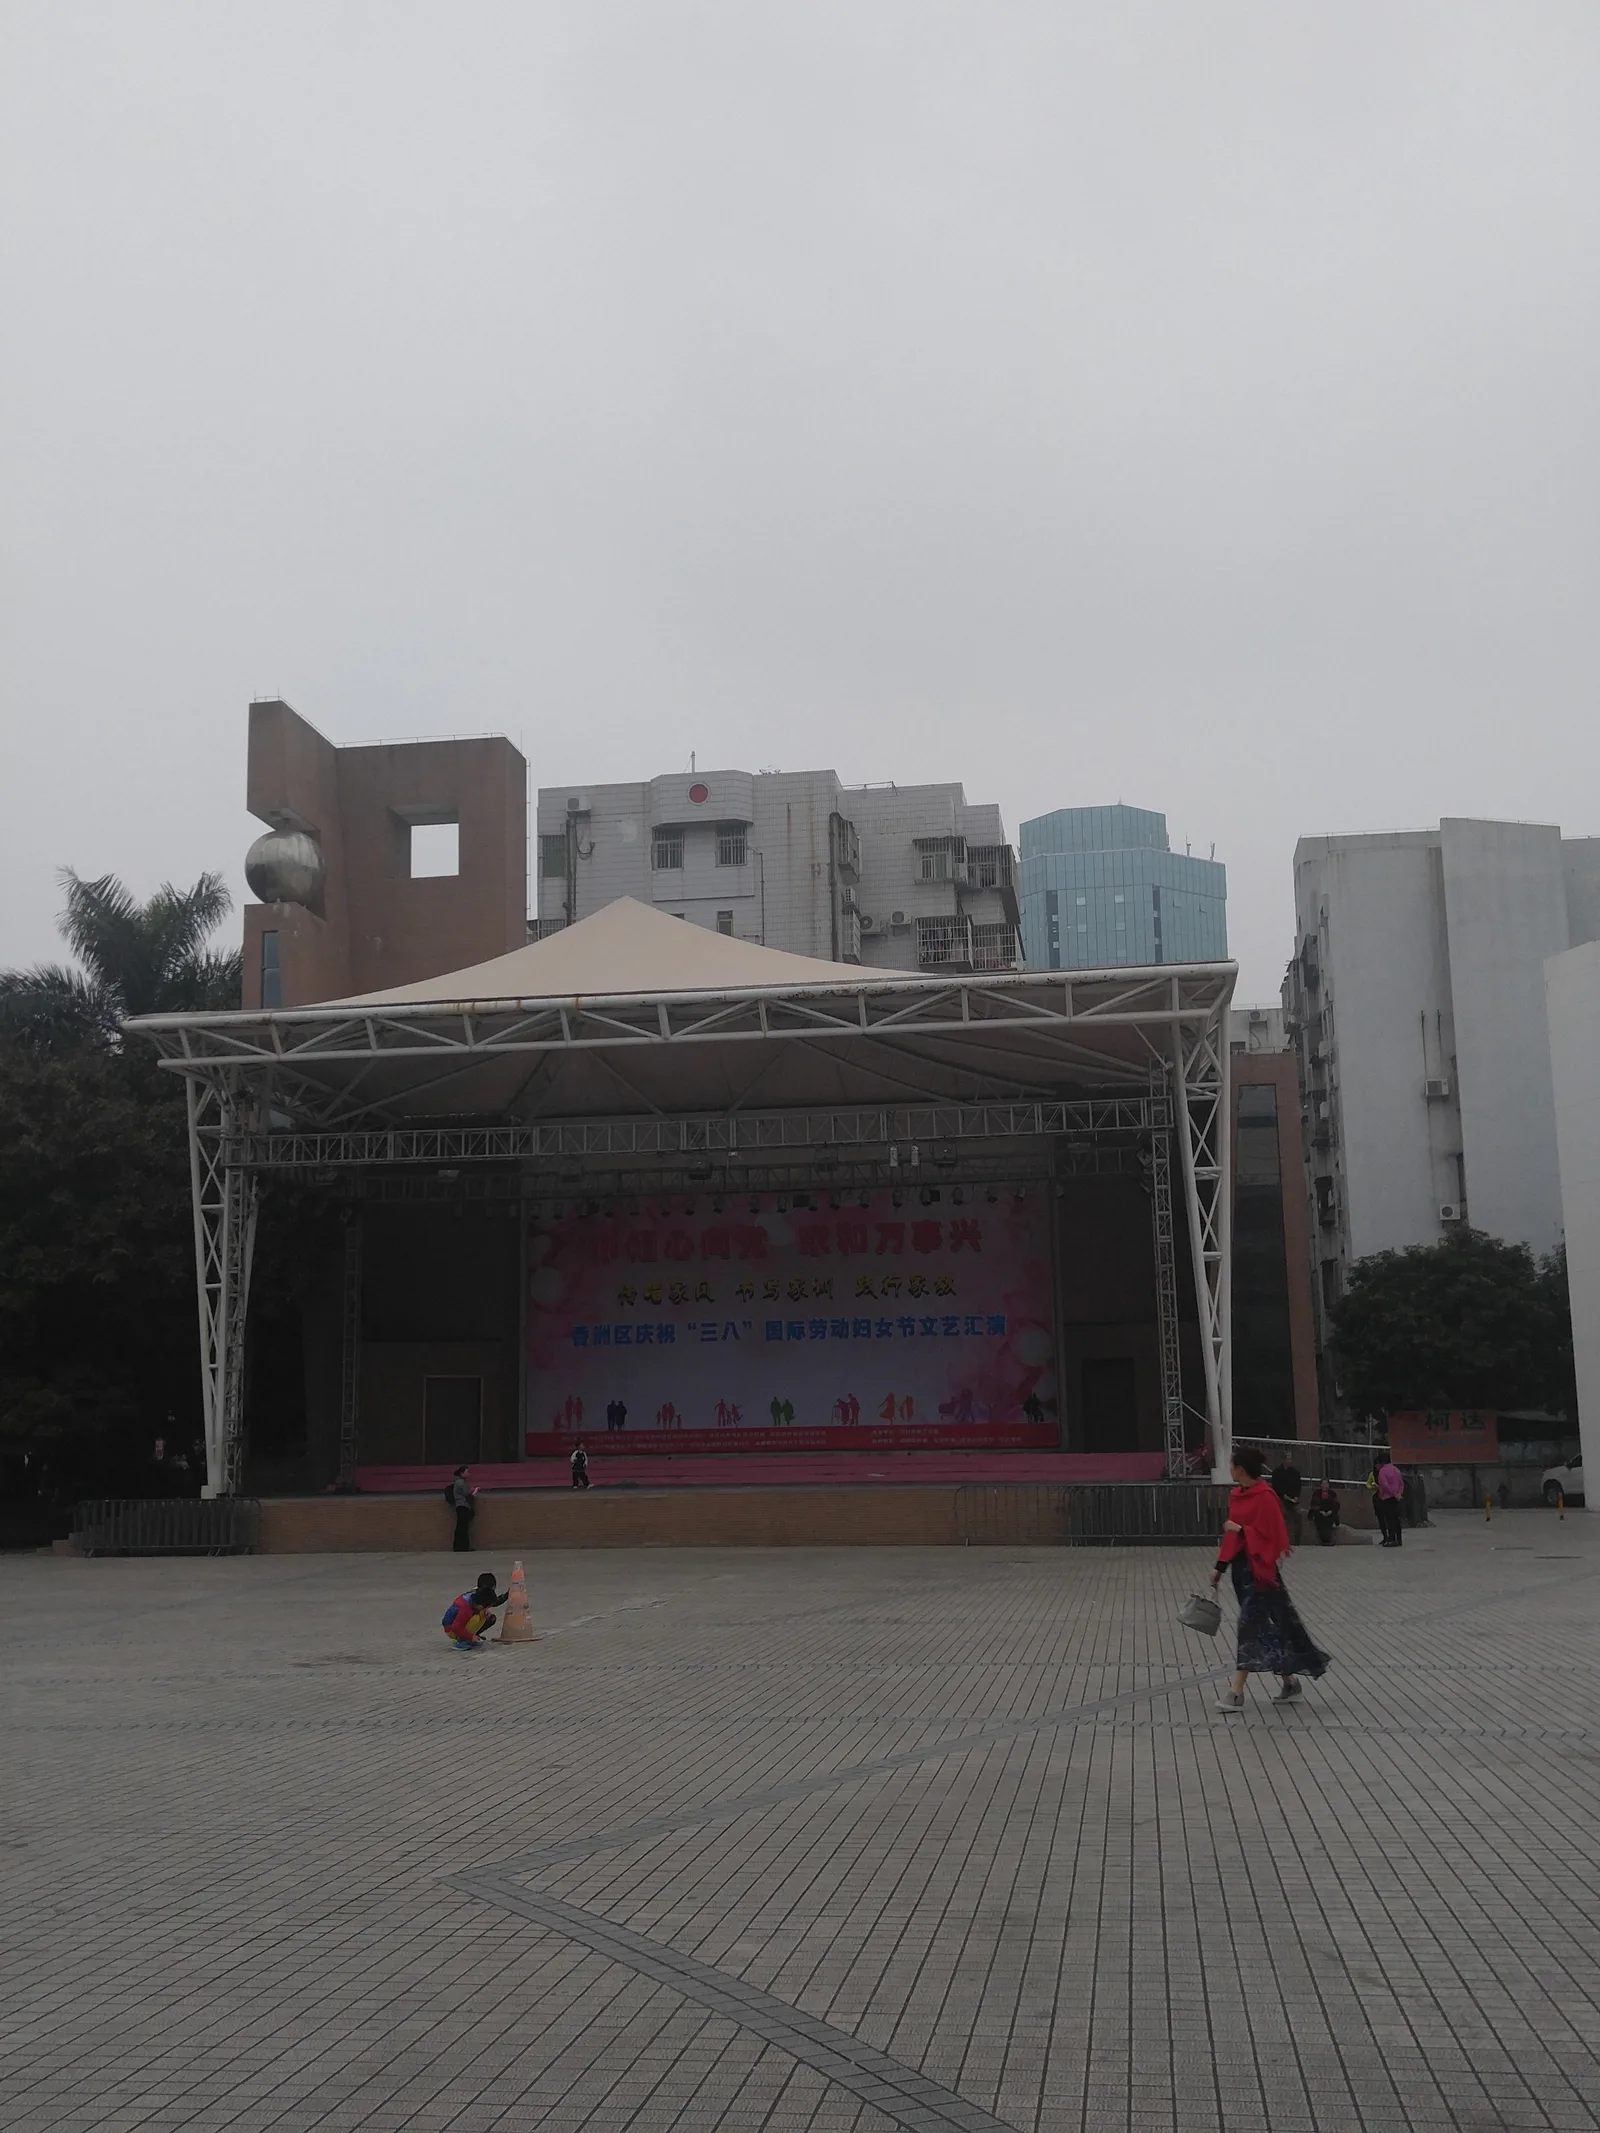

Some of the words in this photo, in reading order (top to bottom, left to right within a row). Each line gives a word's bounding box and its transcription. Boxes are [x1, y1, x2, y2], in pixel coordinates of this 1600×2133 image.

[797, 1219, 983, 1258] 家和万事兴
